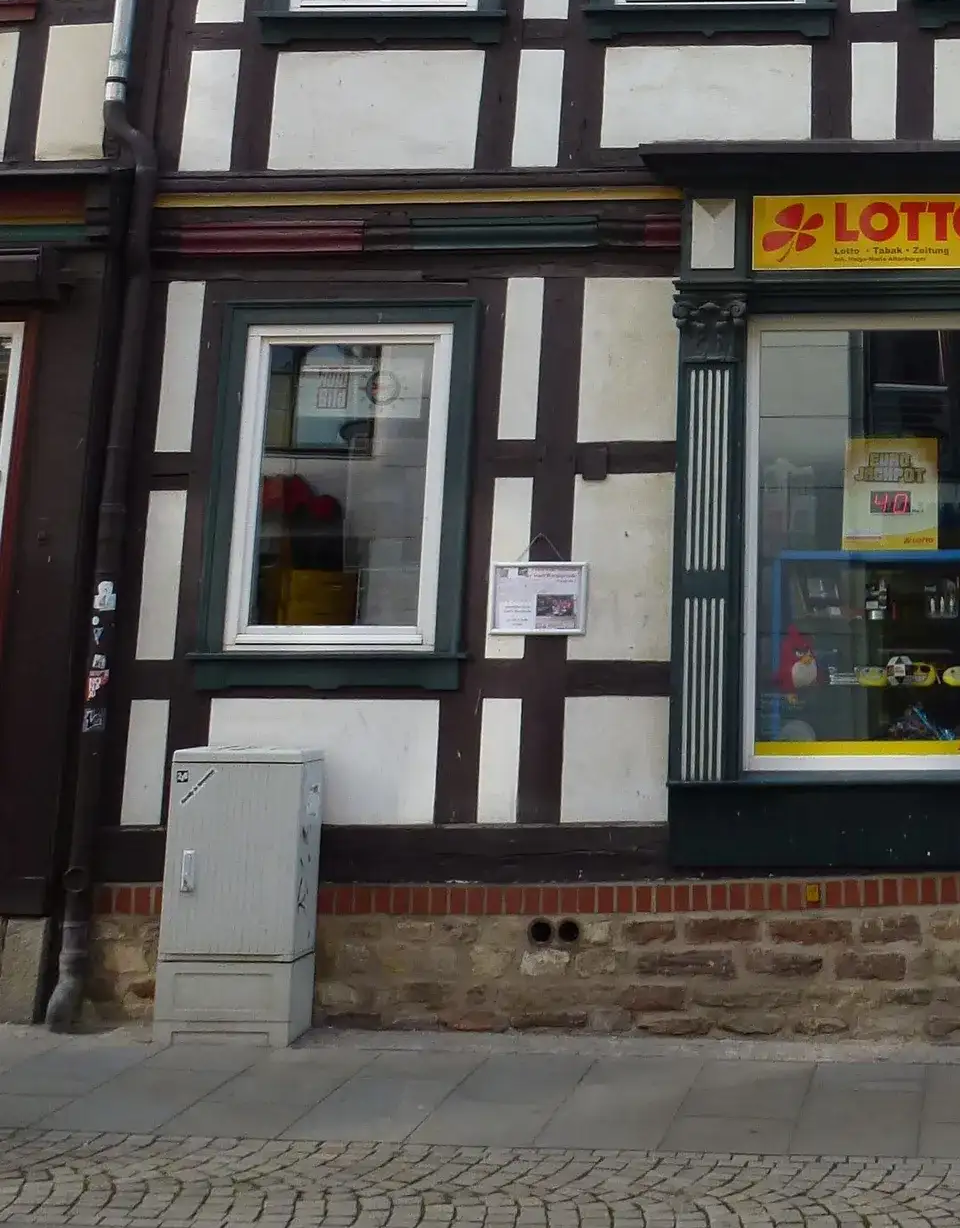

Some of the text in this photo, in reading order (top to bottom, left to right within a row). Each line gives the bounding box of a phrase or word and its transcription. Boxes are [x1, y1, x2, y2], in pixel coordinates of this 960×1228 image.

[834, 246, 949, 256] Lotto Tabak Zeitung
[873, 492, 908, 514] 40
